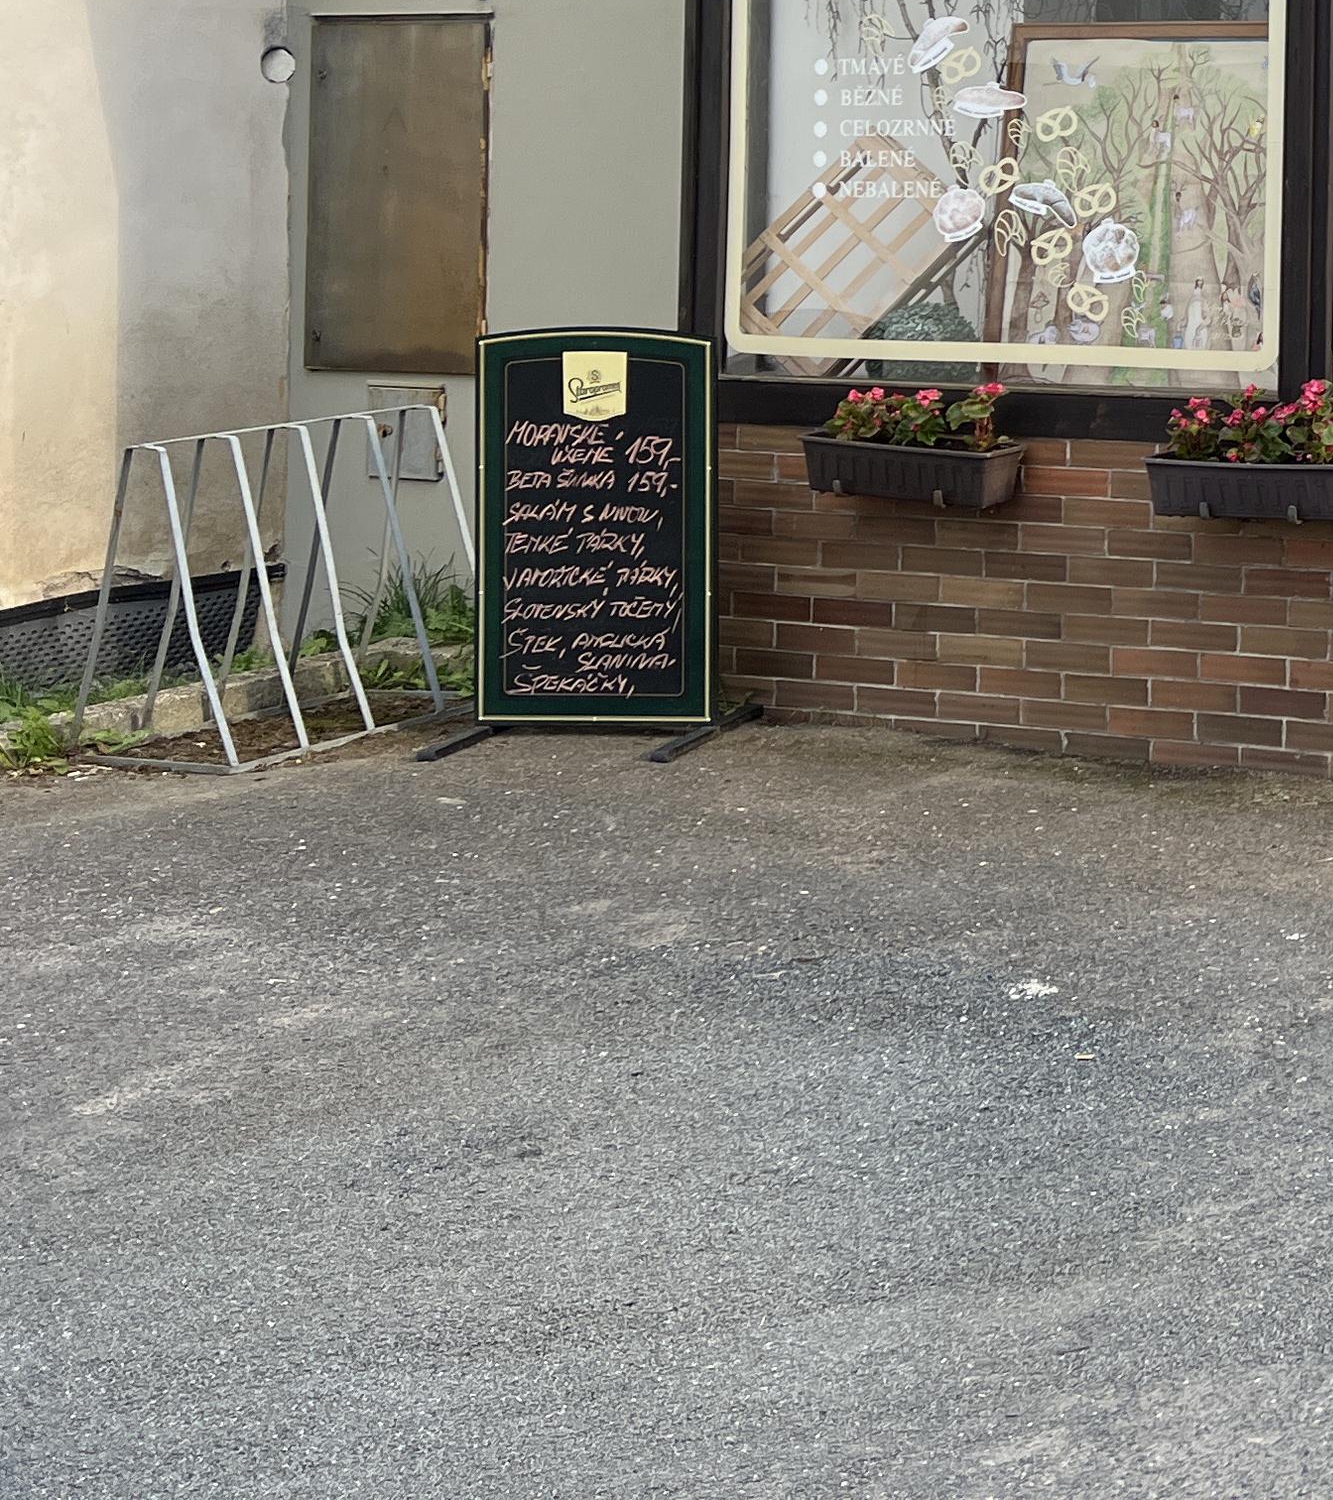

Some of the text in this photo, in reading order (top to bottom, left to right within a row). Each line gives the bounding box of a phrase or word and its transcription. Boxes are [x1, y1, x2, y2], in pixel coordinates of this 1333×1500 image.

[841, 54, 905, 75] TMAVÉ
[841, 85, 903, 106] BĚŽNÉ
[840, 116, 956, 137] CELOZRNNÉ
[840, 146, 916, 168] BALENÉ
[839, 177, 941, 198] NEBALENÉ
[504, 470, 552, 492] BETA
[502, 498, 577, 526] SALÁM
[581, 504, 594, 523] S
